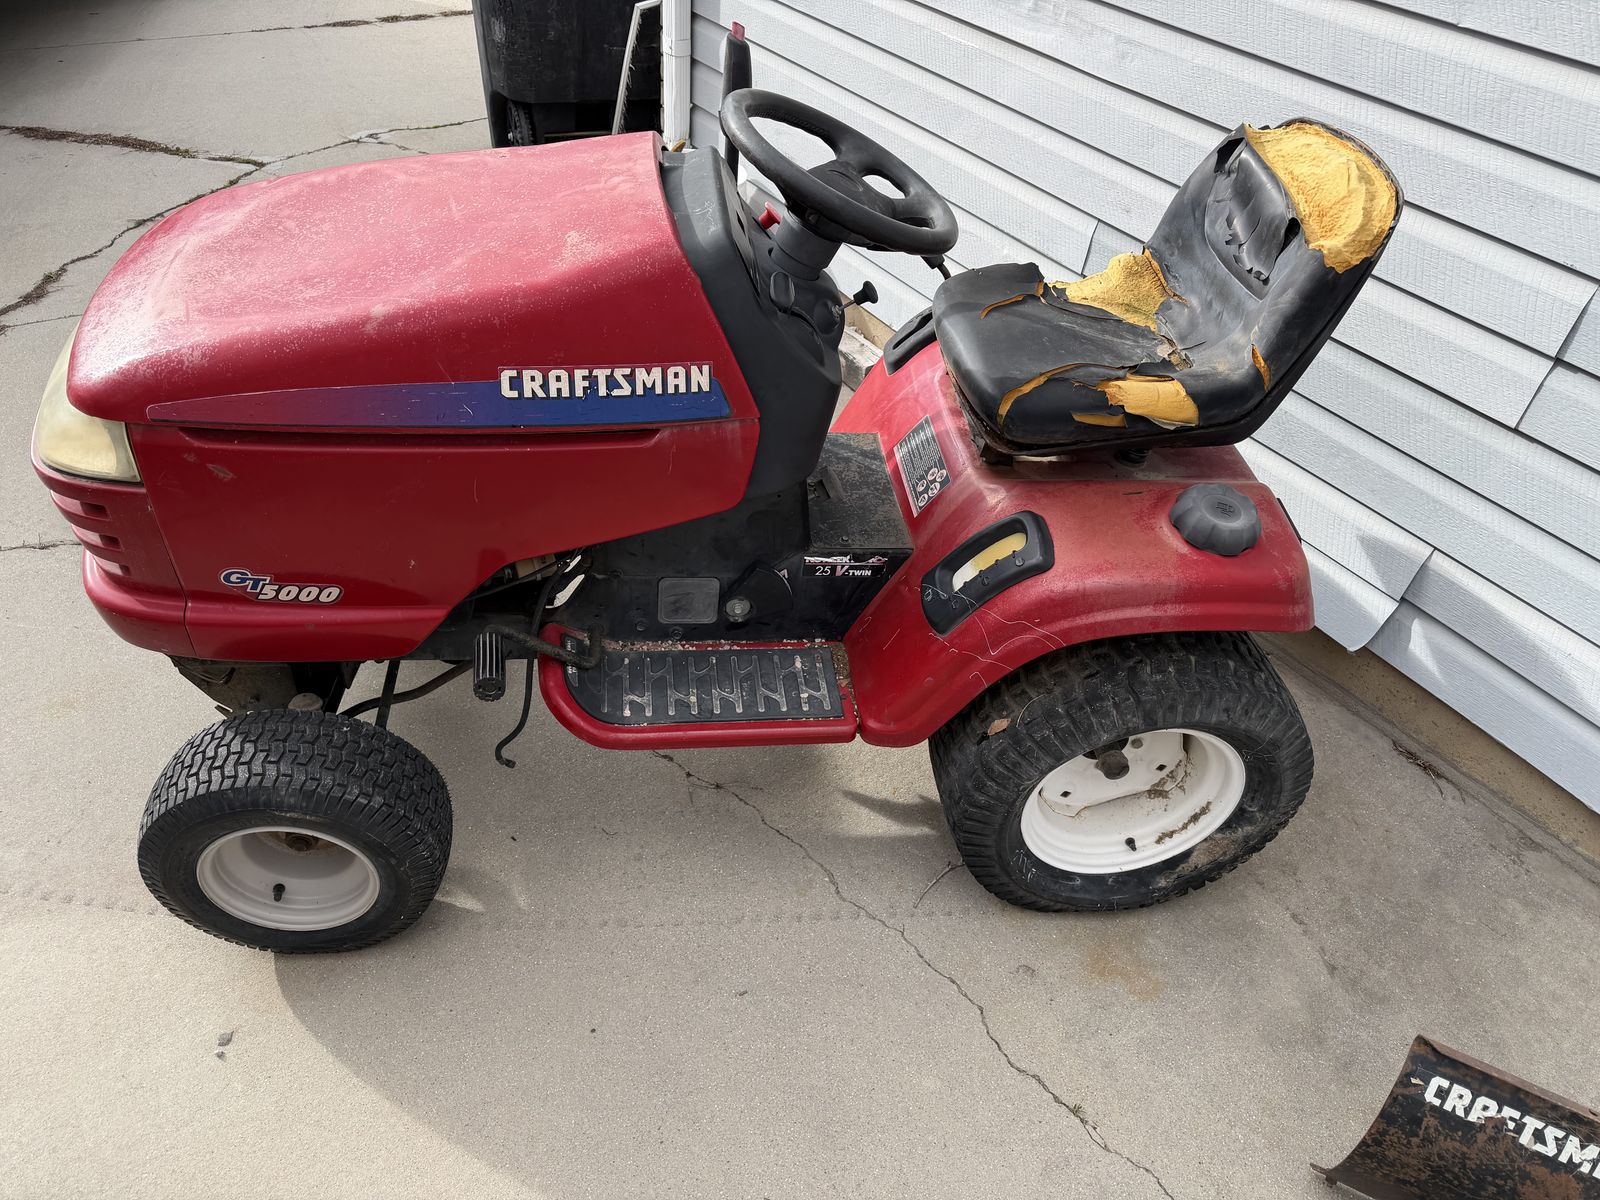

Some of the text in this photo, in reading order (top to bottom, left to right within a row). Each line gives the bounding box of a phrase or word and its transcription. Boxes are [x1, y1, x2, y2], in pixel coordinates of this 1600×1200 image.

[499, 364, 711, 399] CRAFTSMAN
[220, 568, 271, 593] GT
[815, 564, 872, 577] 25 V-TWIN
[257, 584, 342, 603] 5000
[1423, 1075, 1600, 1179] CRAFTSM
